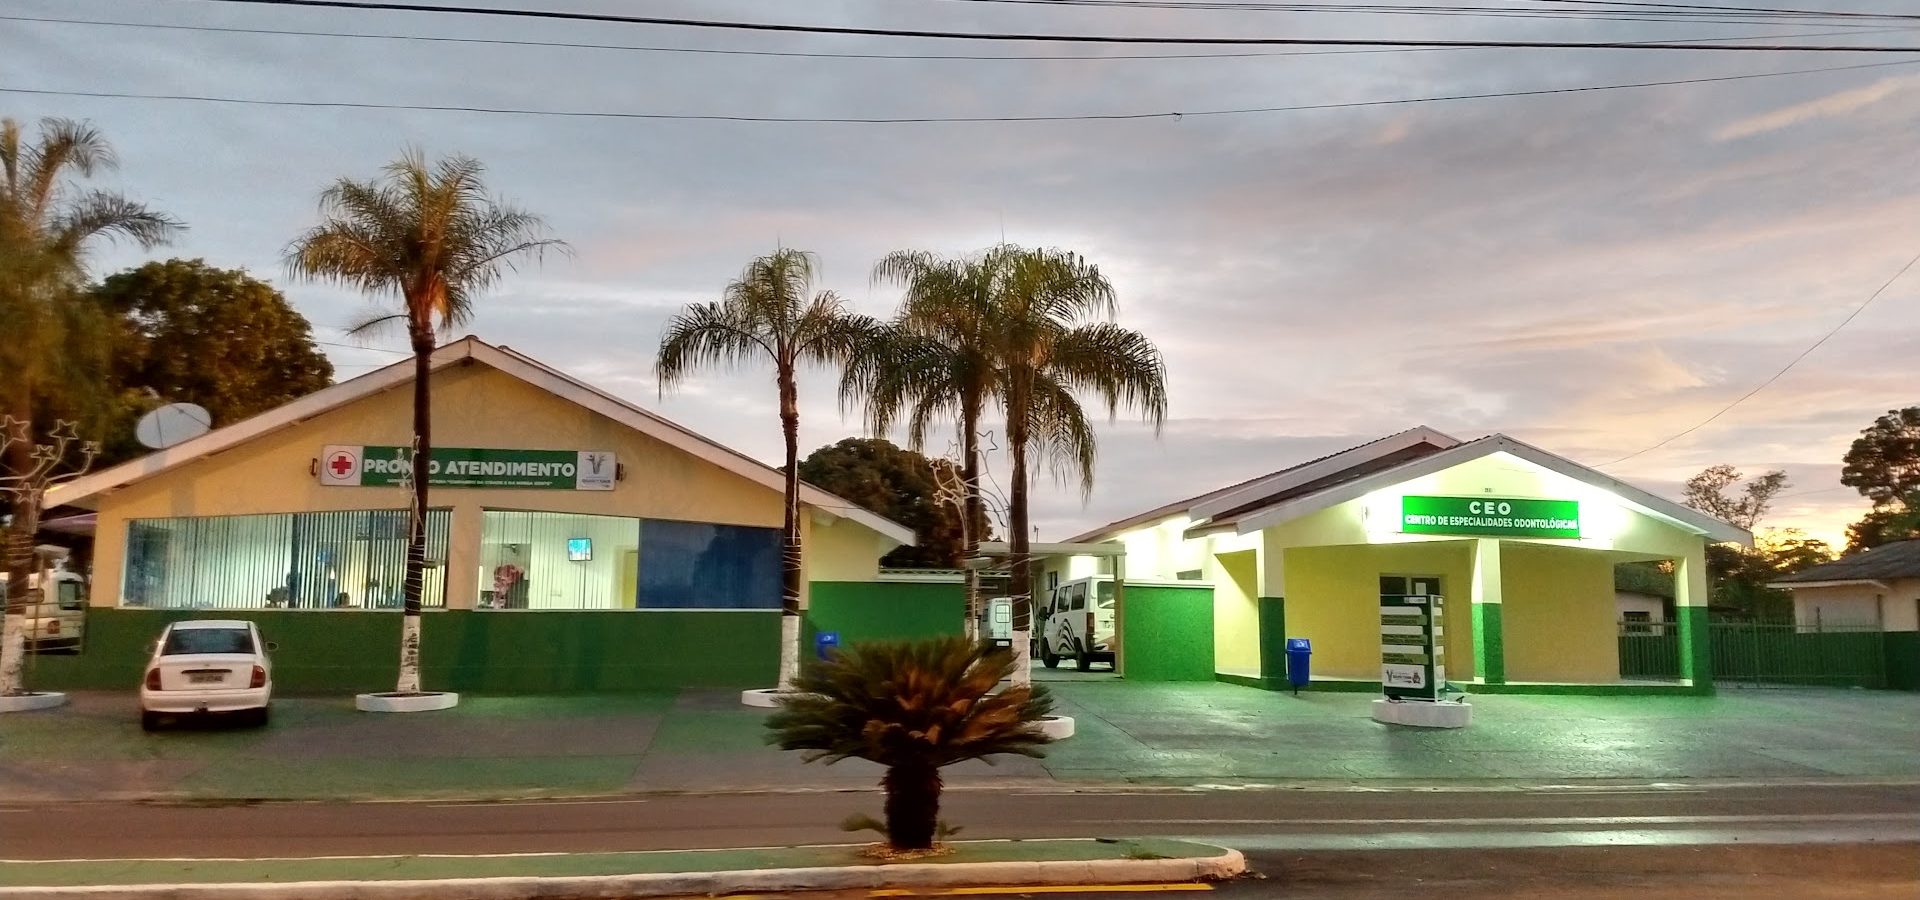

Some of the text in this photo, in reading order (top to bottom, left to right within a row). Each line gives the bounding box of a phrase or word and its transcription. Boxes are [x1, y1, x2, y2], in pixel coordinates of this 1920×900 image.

[363, 459, 575, 477] PRONO ATENDIMENTO
[1469, 501, 1511, 516] CEO
[1437, 516, 1449, 526] DE
[1449, 517, 1513, 528] ESPECIALIDADES
